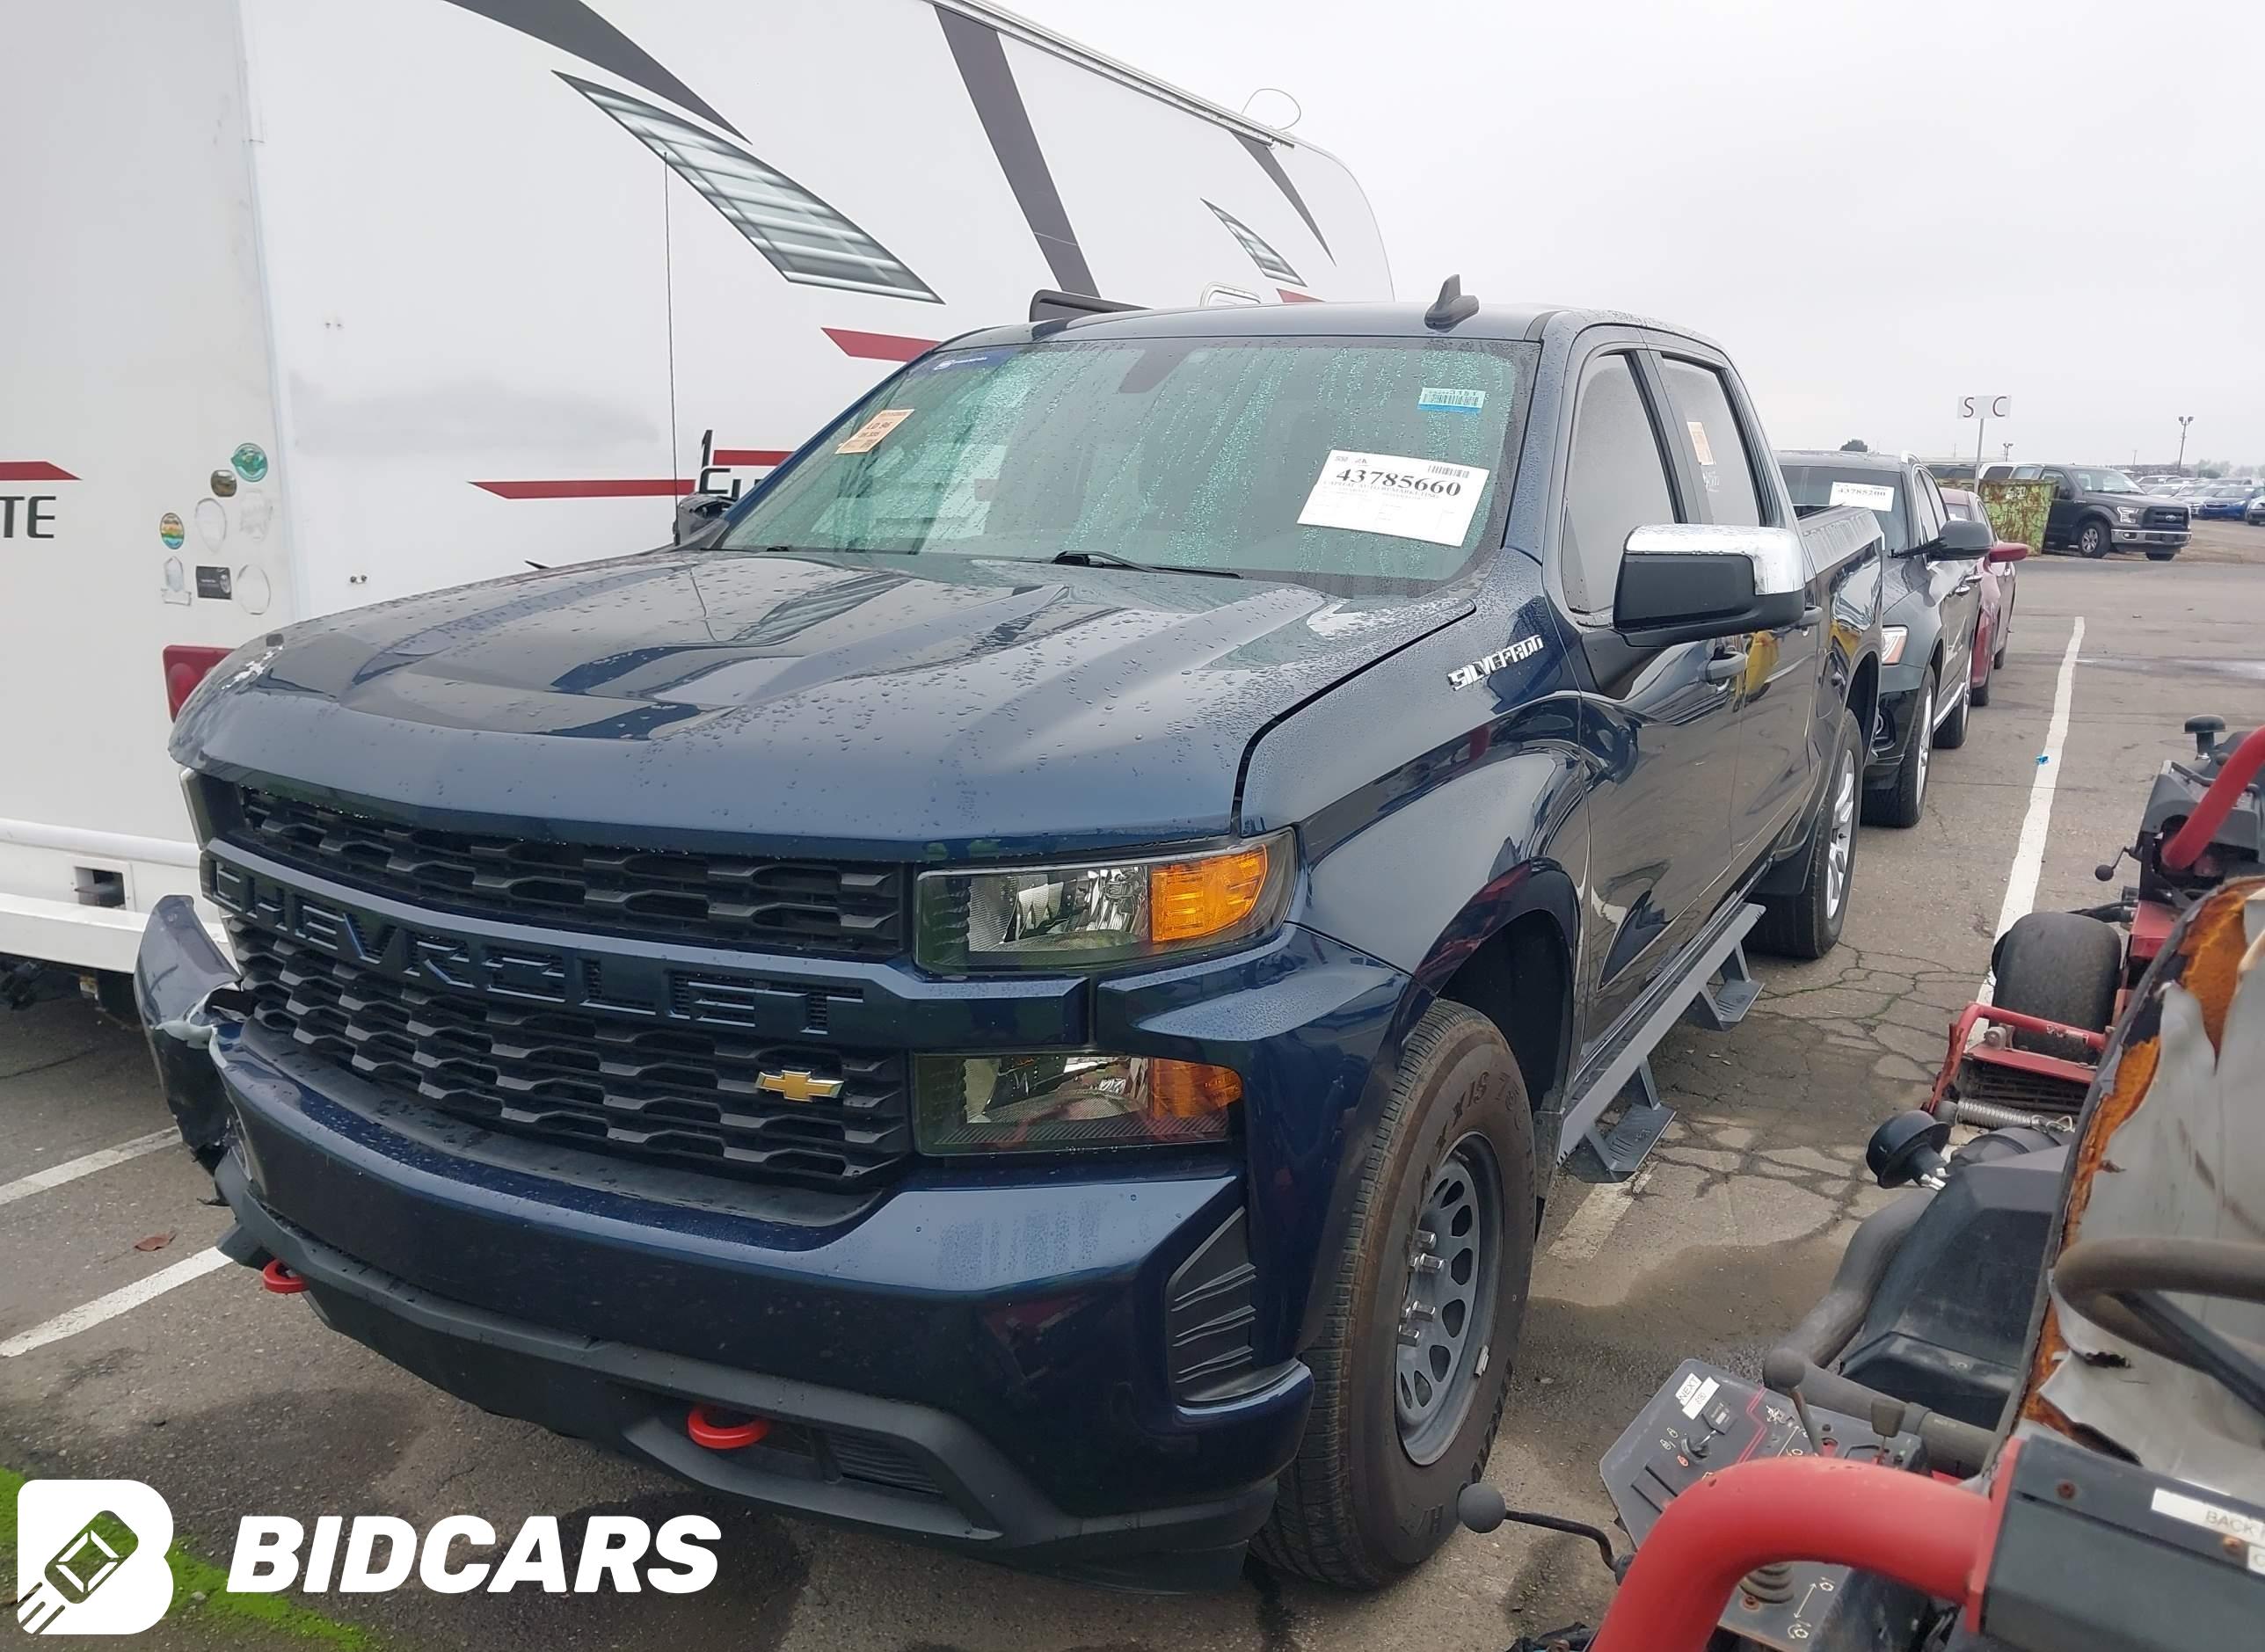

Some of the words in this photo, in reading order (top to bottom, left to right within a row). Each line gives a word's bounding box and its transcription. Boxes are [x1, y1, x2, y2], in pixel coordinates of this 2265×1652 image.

[1963, 397, 1975, 418] S
[1992, 396, 2007, 418] C
[1336, 468, 1461, 497] 43785660
[1447, 634, 1544, 692] SILVERADO
[213, 860, 864, 1035] CHEVROLET
[1679, 1377, 1699, 1402] NEXT
[2207, 1510, 2255, 1537] BACK
